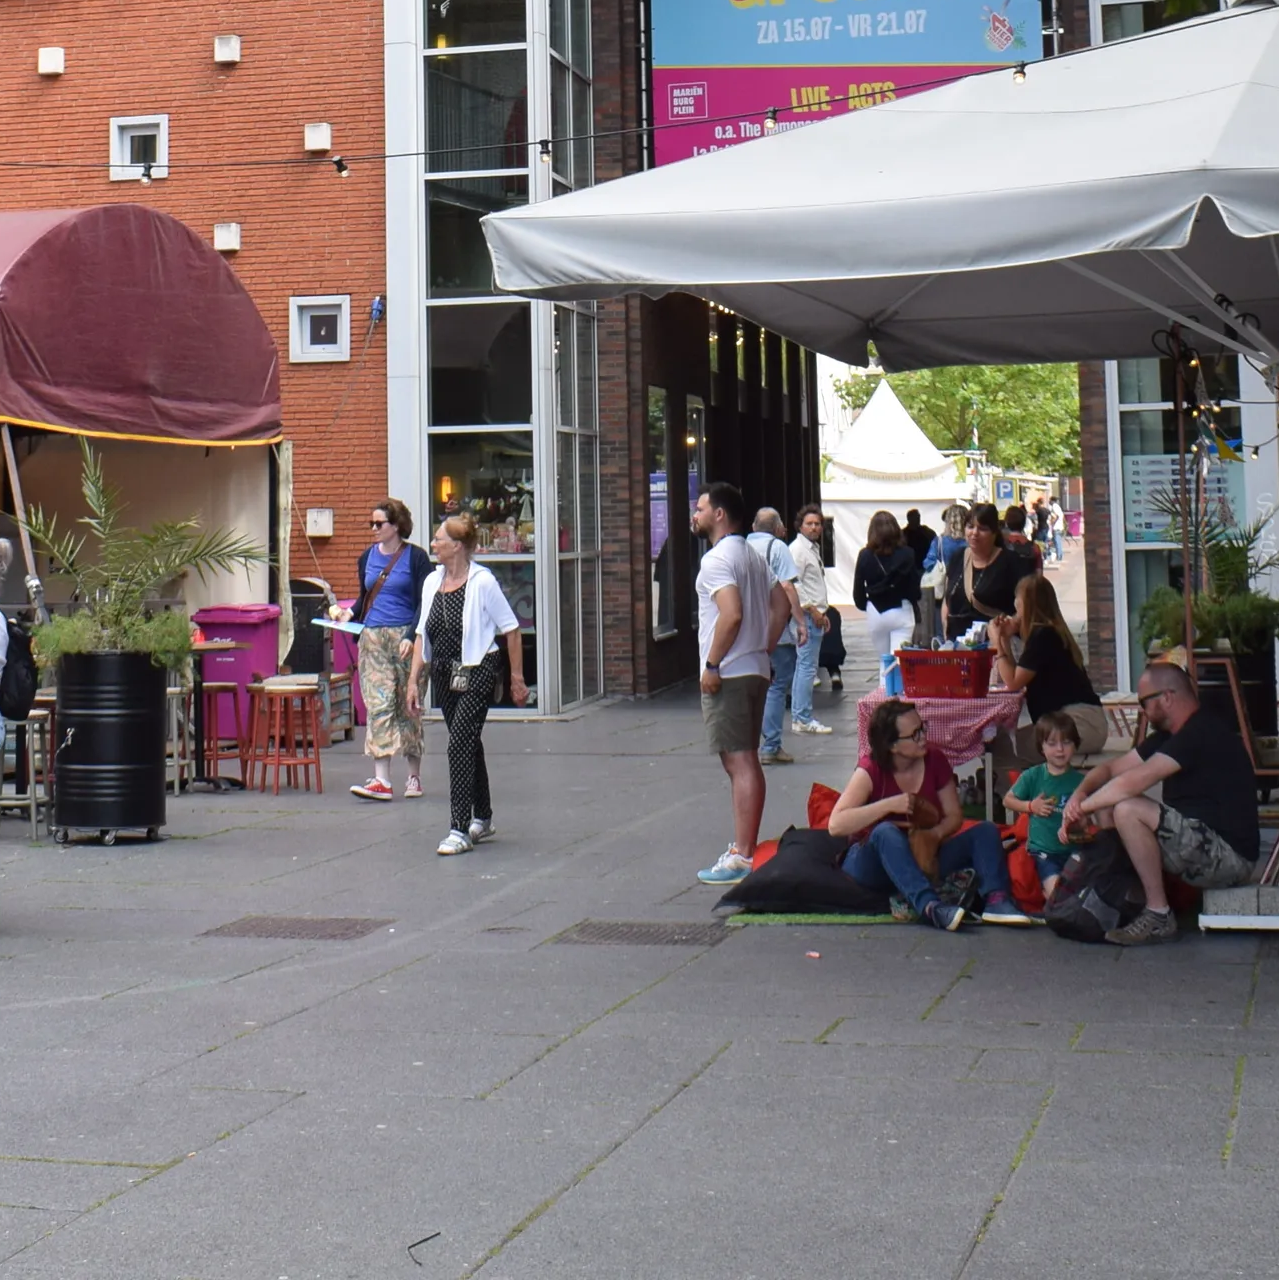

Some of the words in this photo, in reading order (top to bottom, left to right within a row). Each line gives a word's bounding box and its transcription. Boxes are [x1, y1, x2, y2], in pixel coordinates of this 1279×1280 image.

[757, 20, 779, 44] ZA
[783, 16, 832, 42] 15.07
[847, 13, 871, 38] VR
[876, 9, 927, 36] 21.07
[673, 86, 703, 97] MARIËN
[790, 85, 832, 113] LIVE
[848, 81, 896, 109] ACTS
[673, 97, 695, 106] BURG
[673, 106, 695, 115] PLEIN
[715, 125, 737, 139] o.a.
[738, 121, 761, 138] The
[1000, 482, 1011, 498] P
